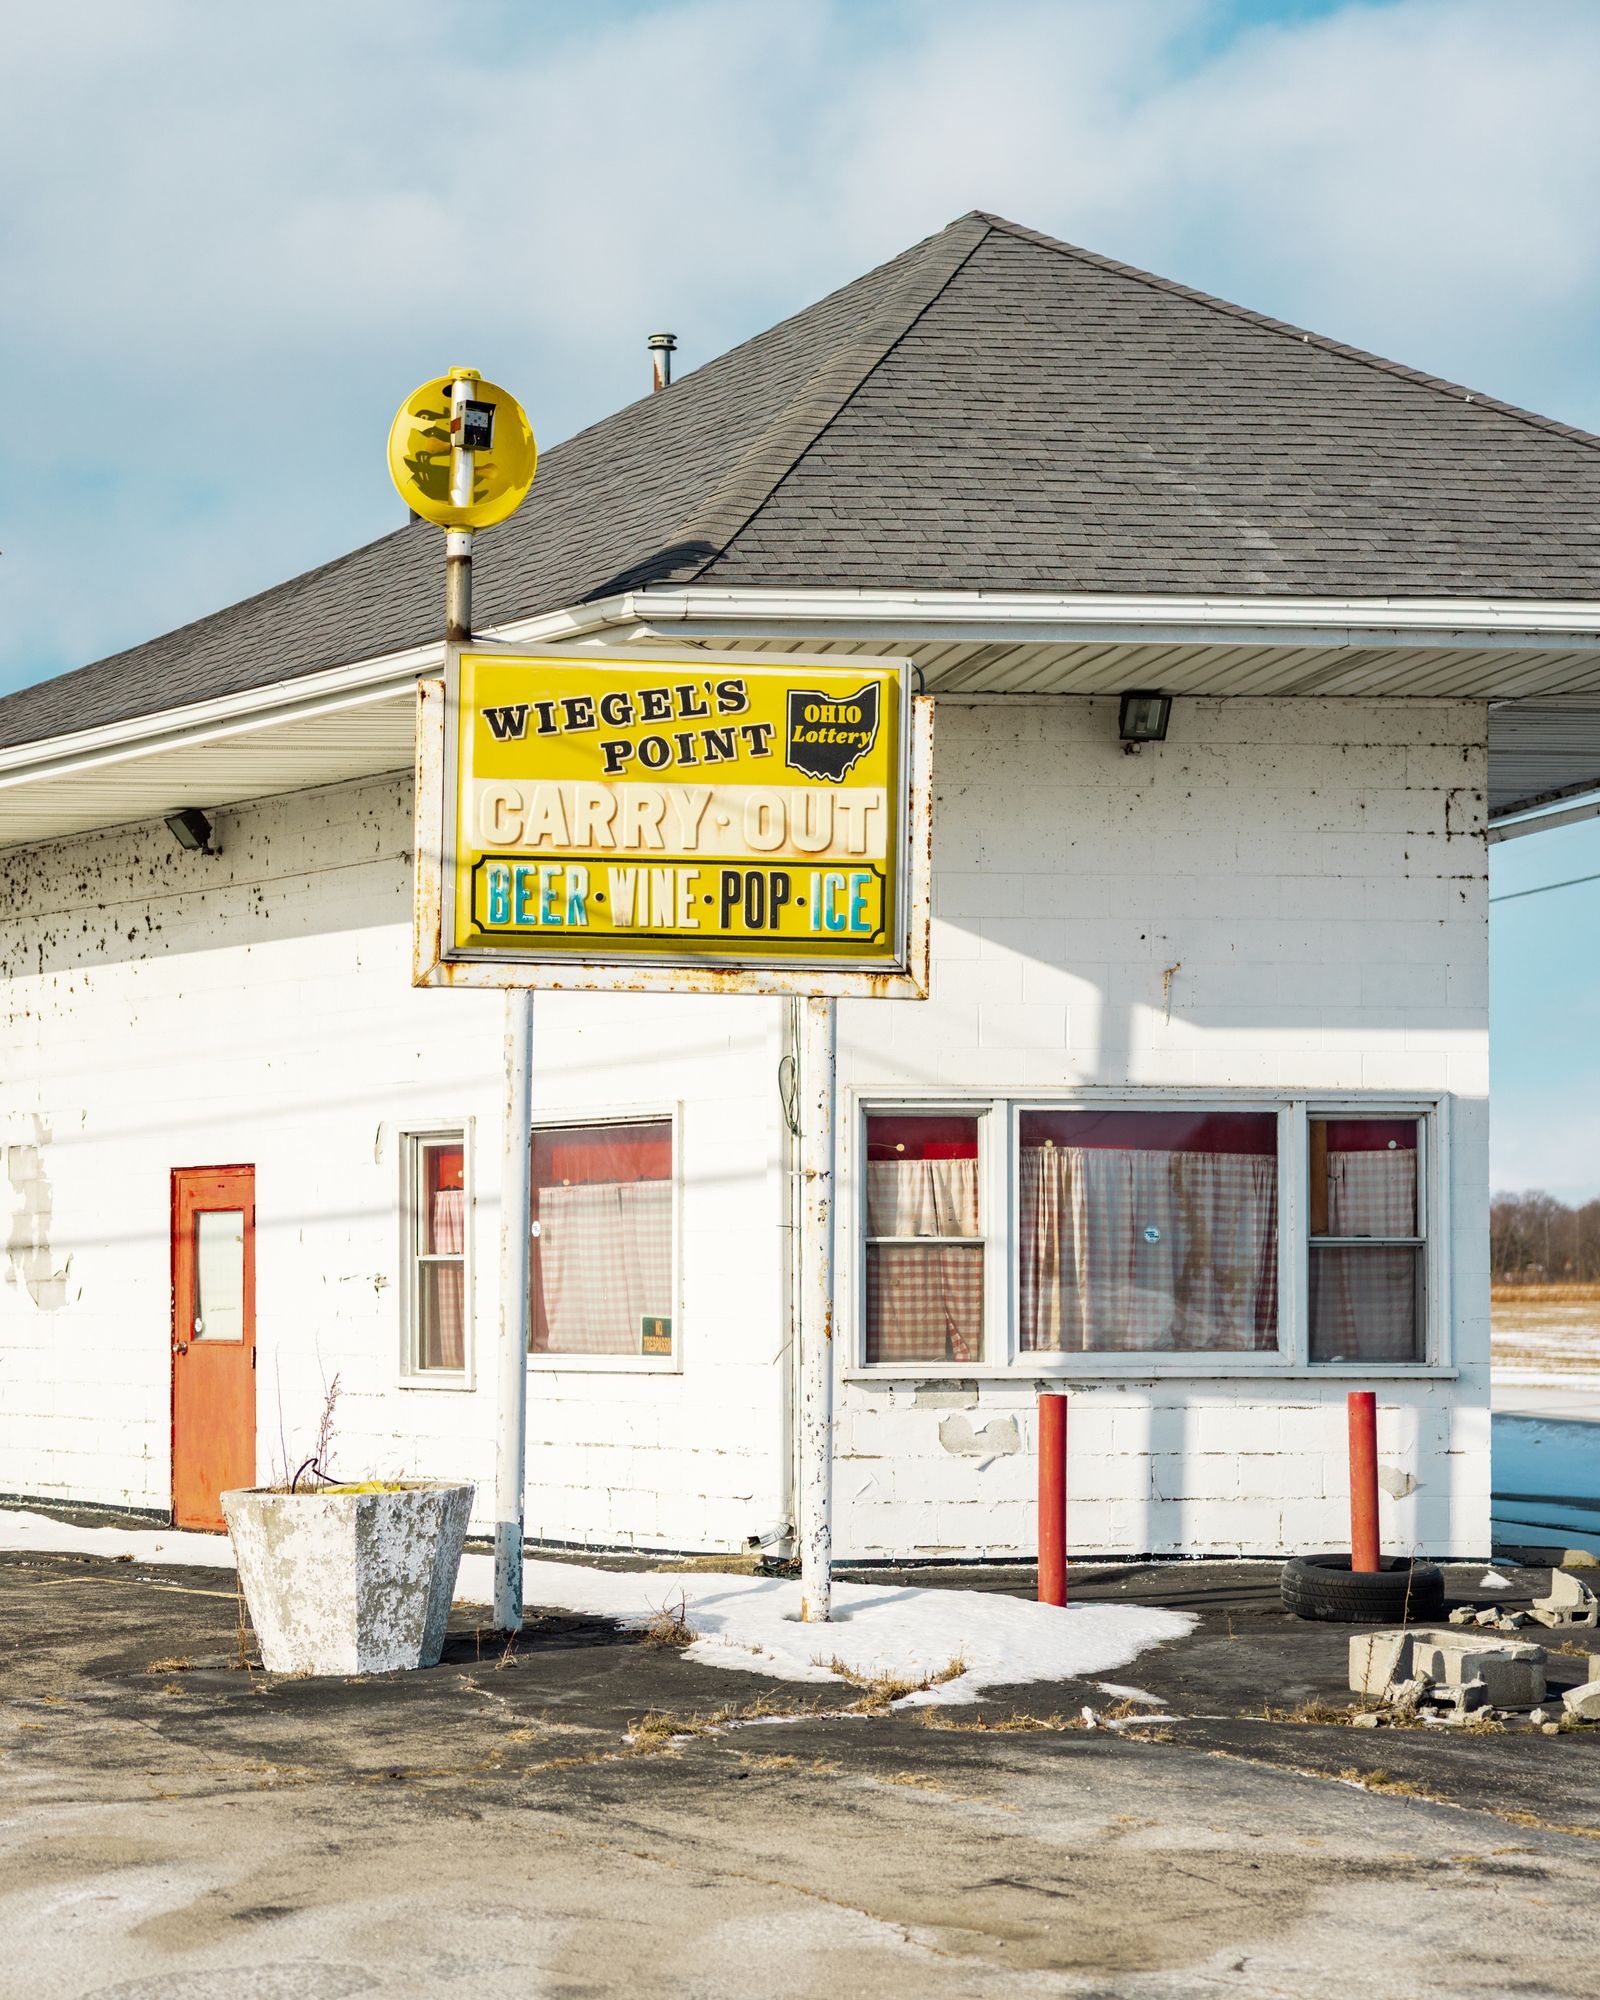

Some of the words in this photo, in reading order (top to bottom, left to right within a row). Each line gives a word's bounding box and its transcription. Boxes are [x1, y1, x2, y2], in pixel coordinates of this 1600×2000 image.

[481, 679, 748, 741] WIEGEL'S
[792, 725, 872, 748] Lottery
[804, 704, 862, 724] OHIO
[599, 723, 773, 774] POINT
[480, 784, 713, 851] CARRY
[744, 790, 880, 854] OUT
[486, 863, 590, 926] BEER
[607, 866, 700, 928] WINE
[719, 869, 790, 930] POP
[810, 871, 871, 932] ICE
